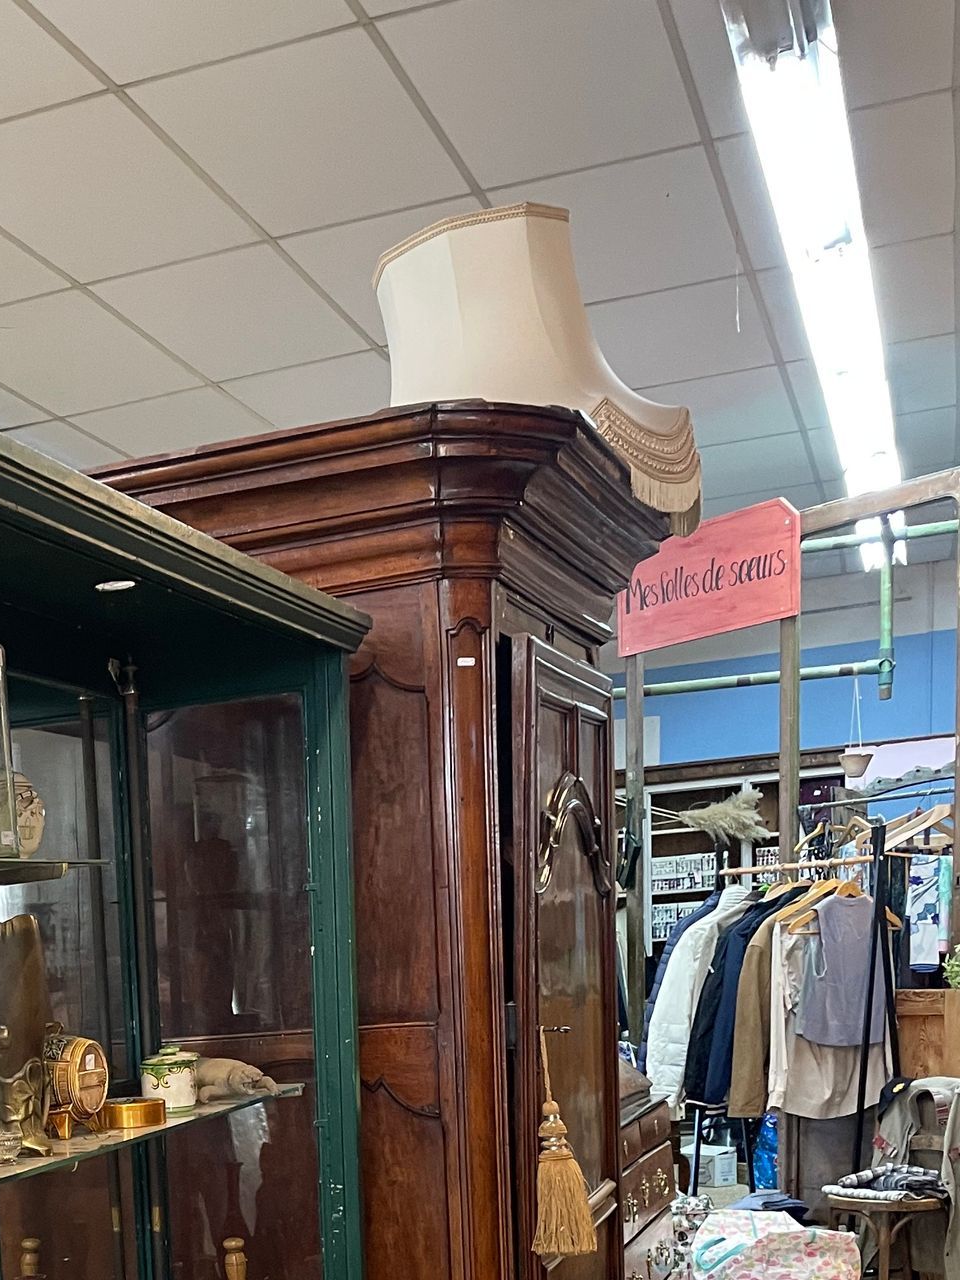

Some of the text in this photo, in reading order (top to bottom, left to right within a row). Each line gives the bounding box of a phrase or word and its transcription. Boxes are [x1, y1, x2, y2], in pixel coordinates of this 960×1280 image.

[625, 549, 786, 614] Mes folles de sœurs
